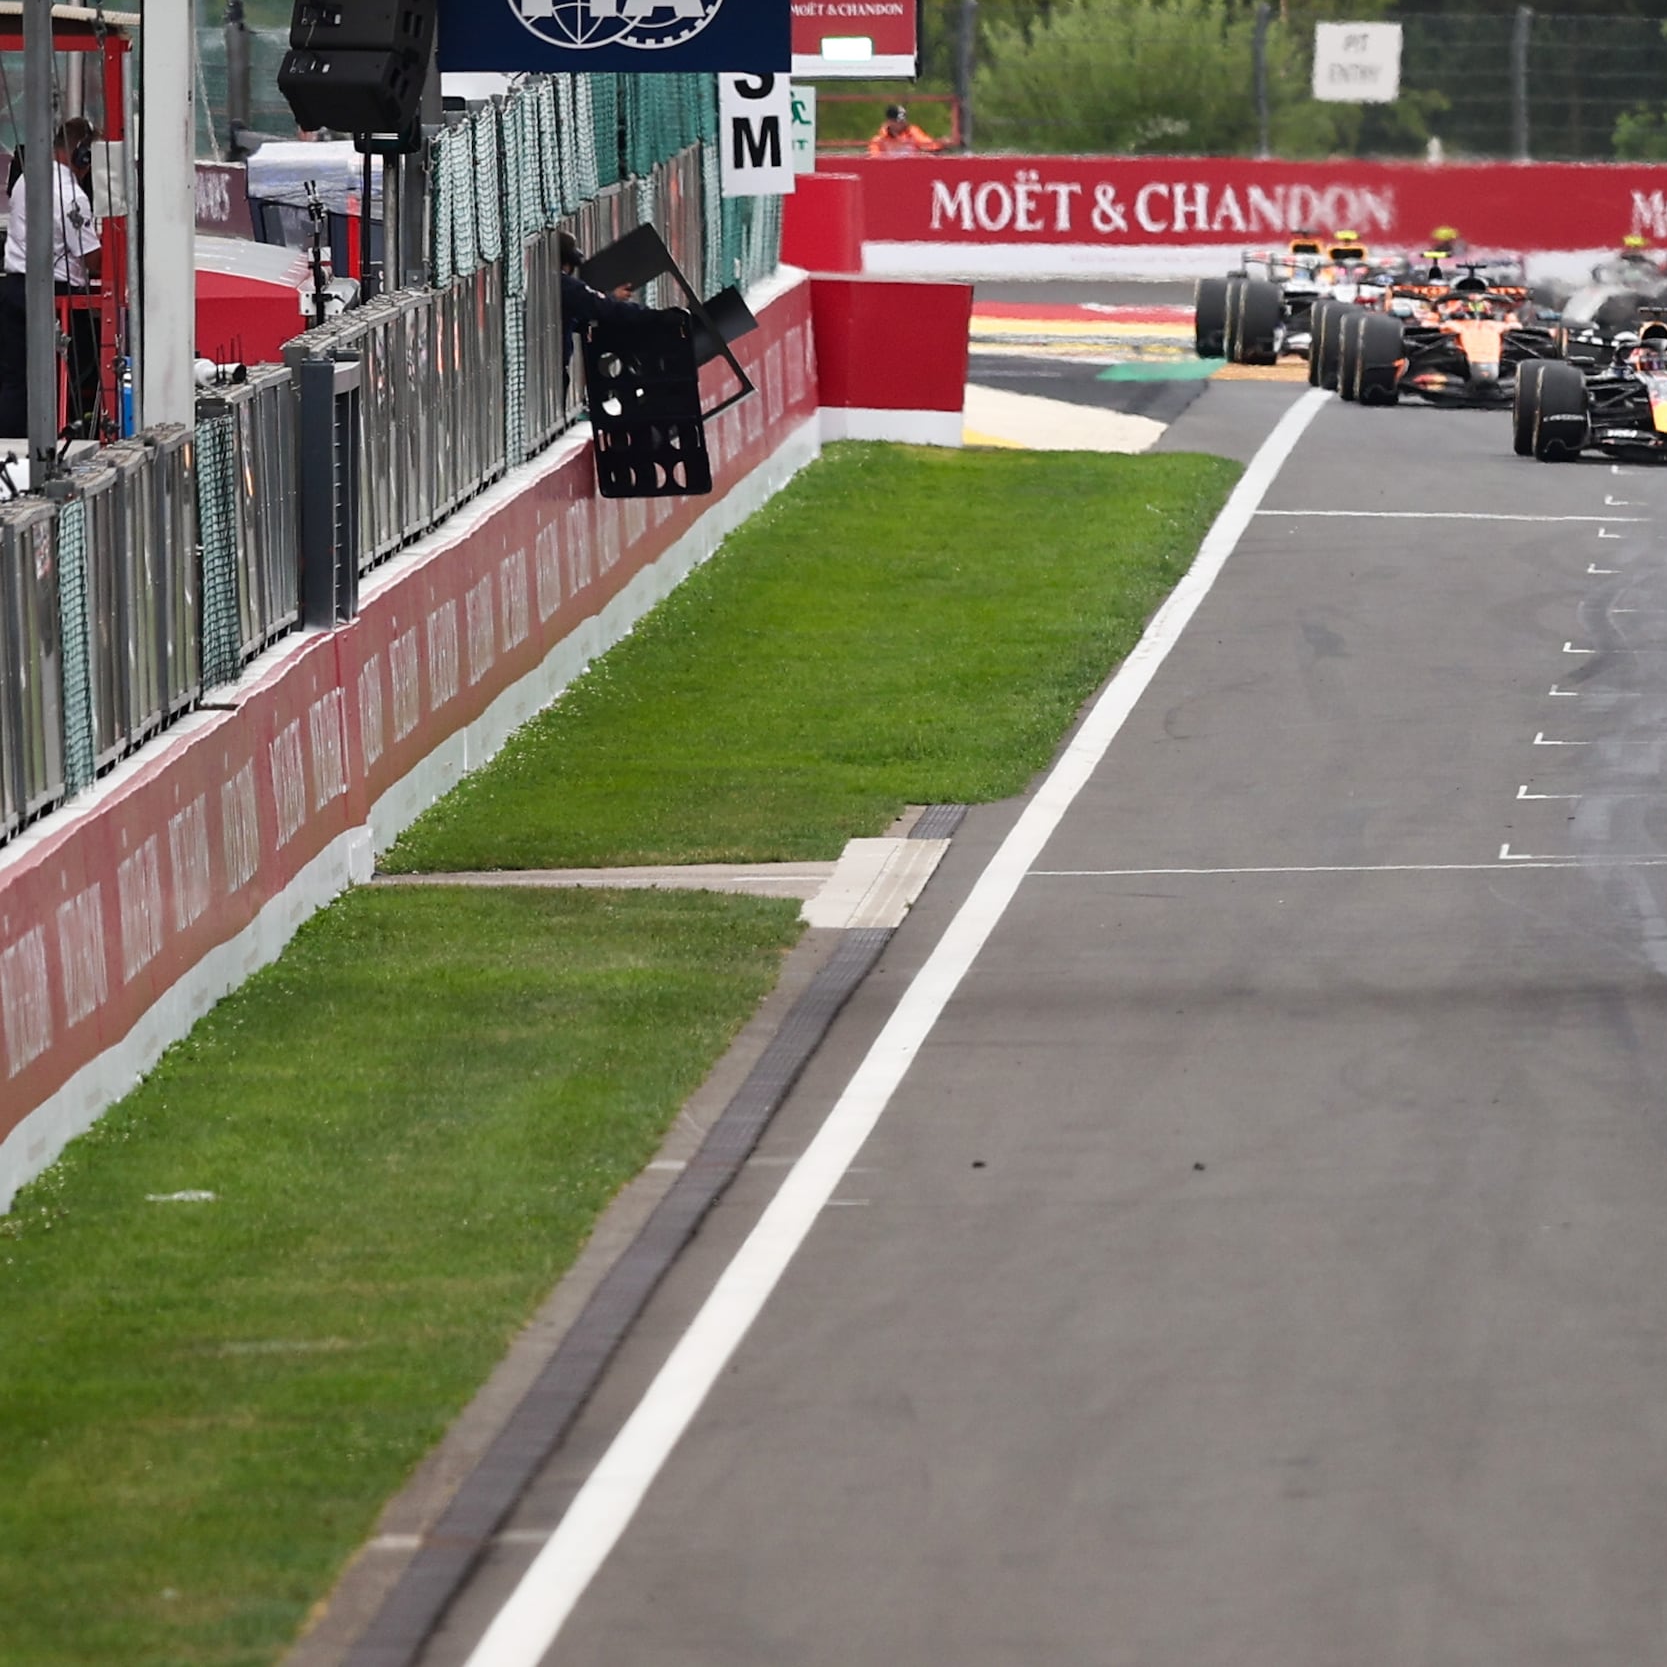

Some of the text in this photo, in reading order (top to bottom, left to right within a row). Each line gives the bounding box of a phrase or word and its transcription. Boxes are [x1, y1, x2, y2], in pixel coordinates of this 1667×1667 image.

[838, 3, 904, 16] CHANDON
[930, 169, 1395, 233] MOËT & CHANDON
